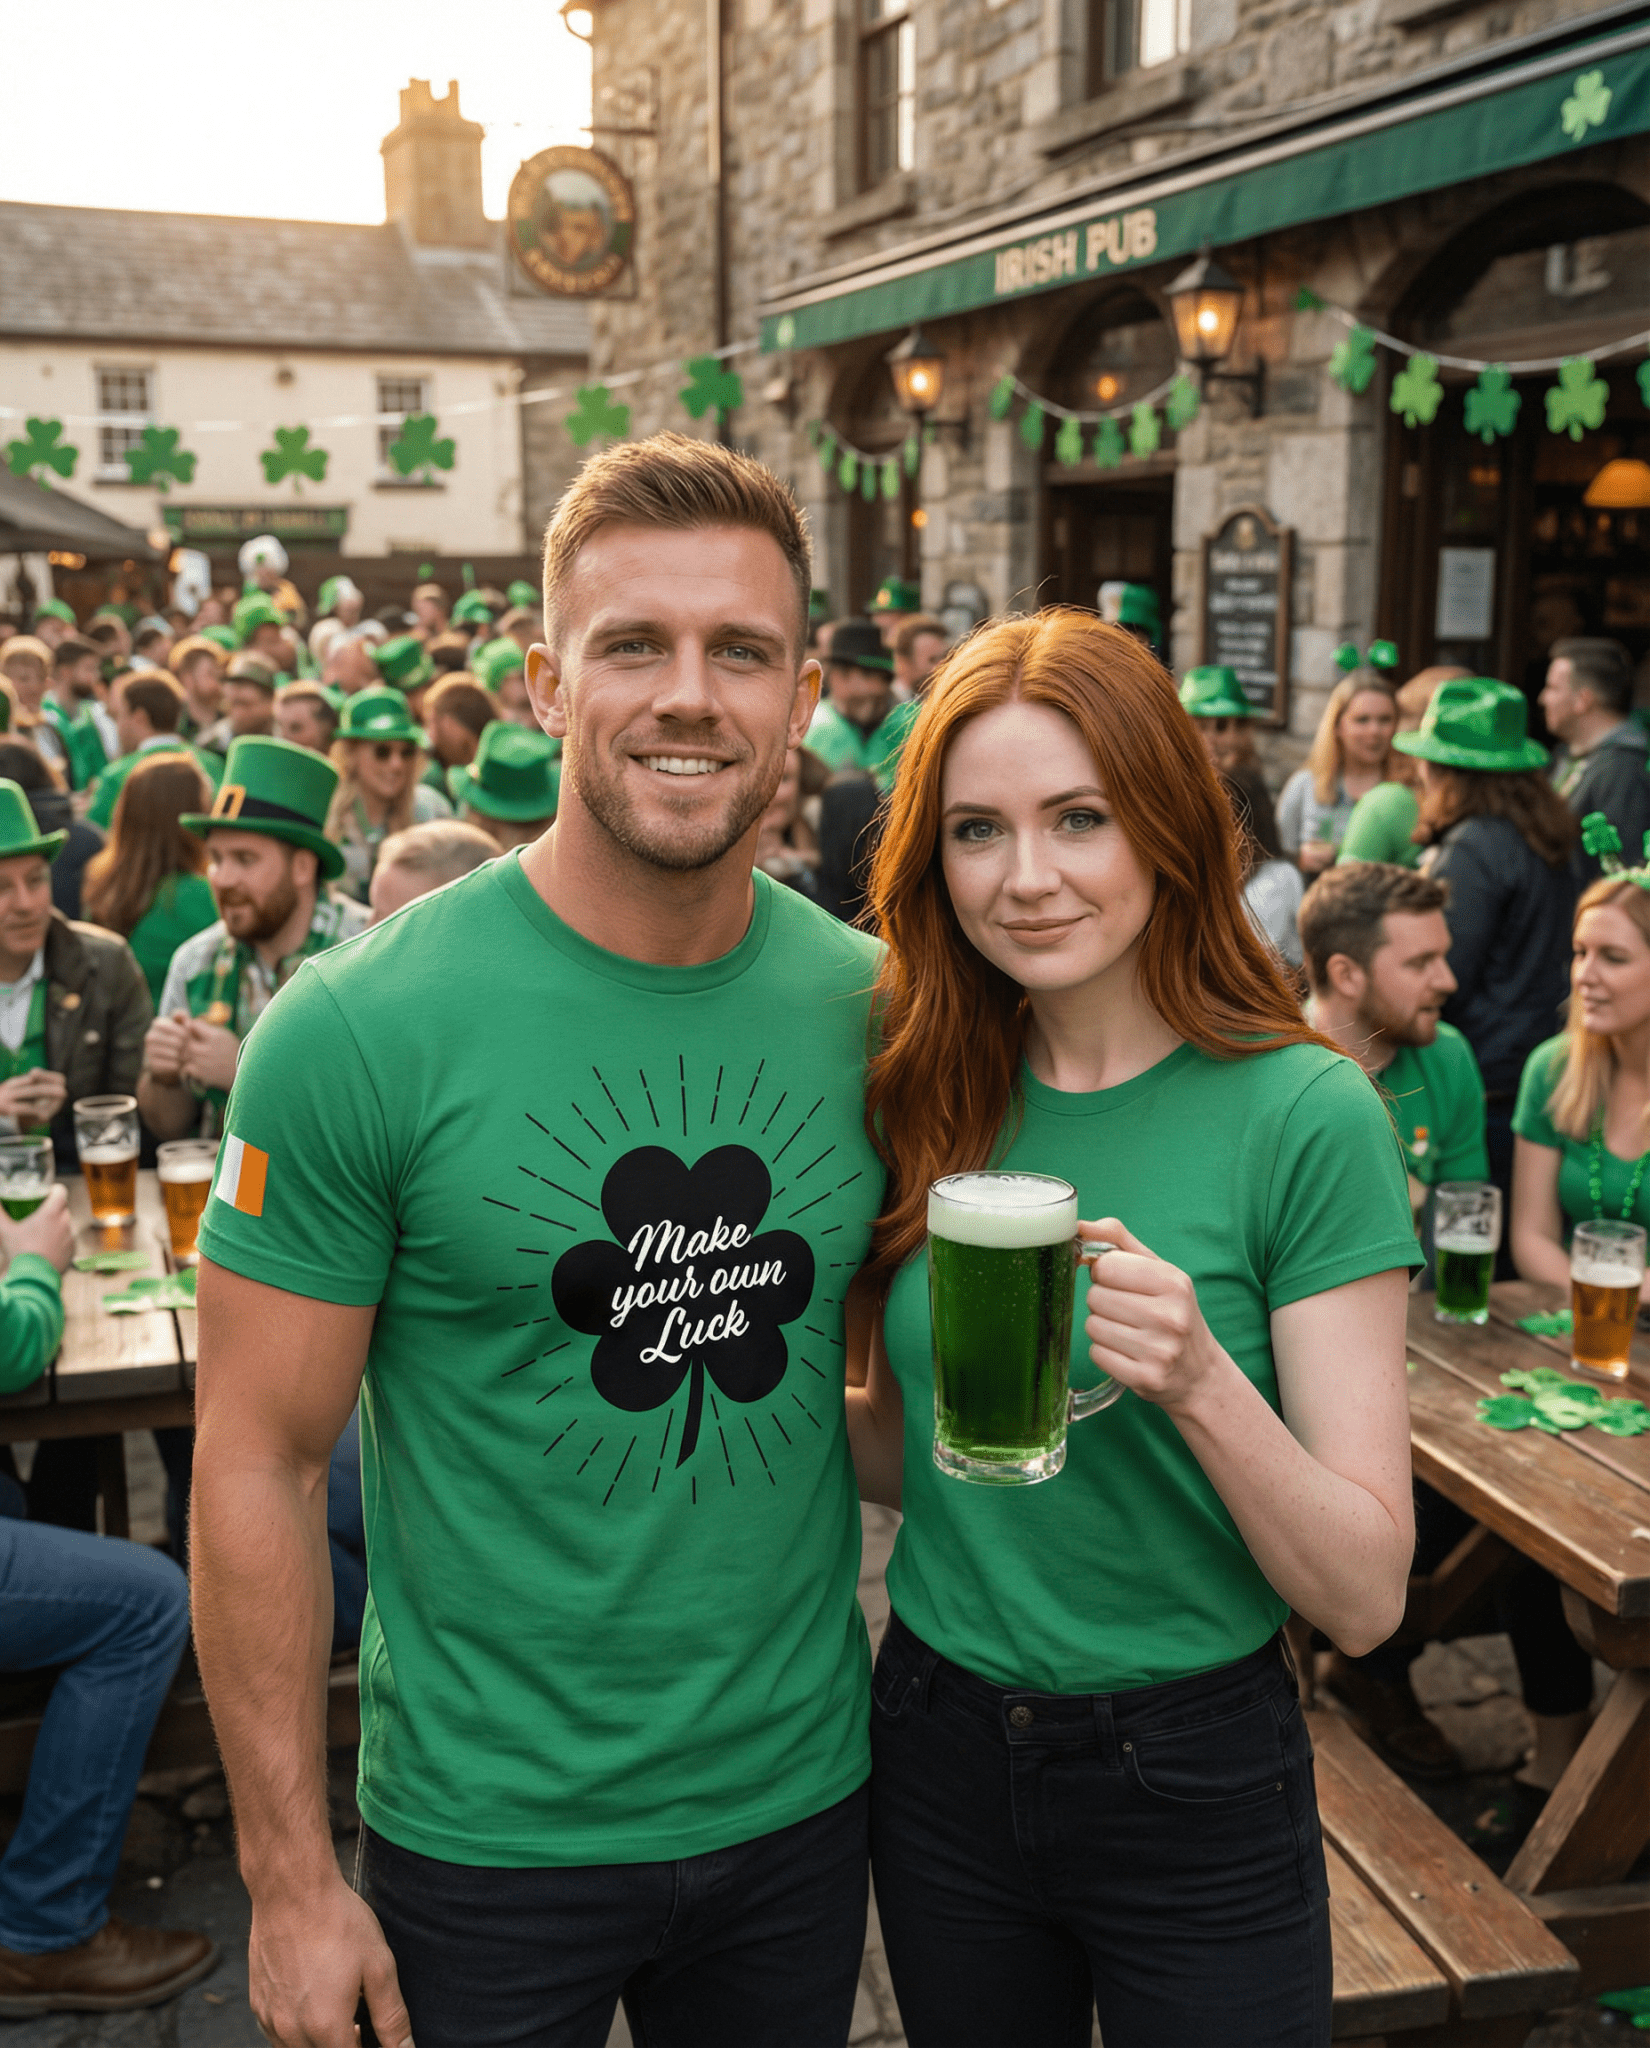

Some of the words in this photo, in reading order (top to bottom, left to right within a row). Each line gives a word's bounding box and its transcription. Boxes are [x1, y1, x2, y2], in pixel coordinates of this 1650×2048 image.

[994, 229, 1079, 295] IRISH
[1085, 207, 1158, 272] PUB
[627, 1215, 752, 1272] Make
[610, 1265, 704, 1328] your
[709, 1260, 787, 1295] own
[639, 1299, 750, 1364] Luck
